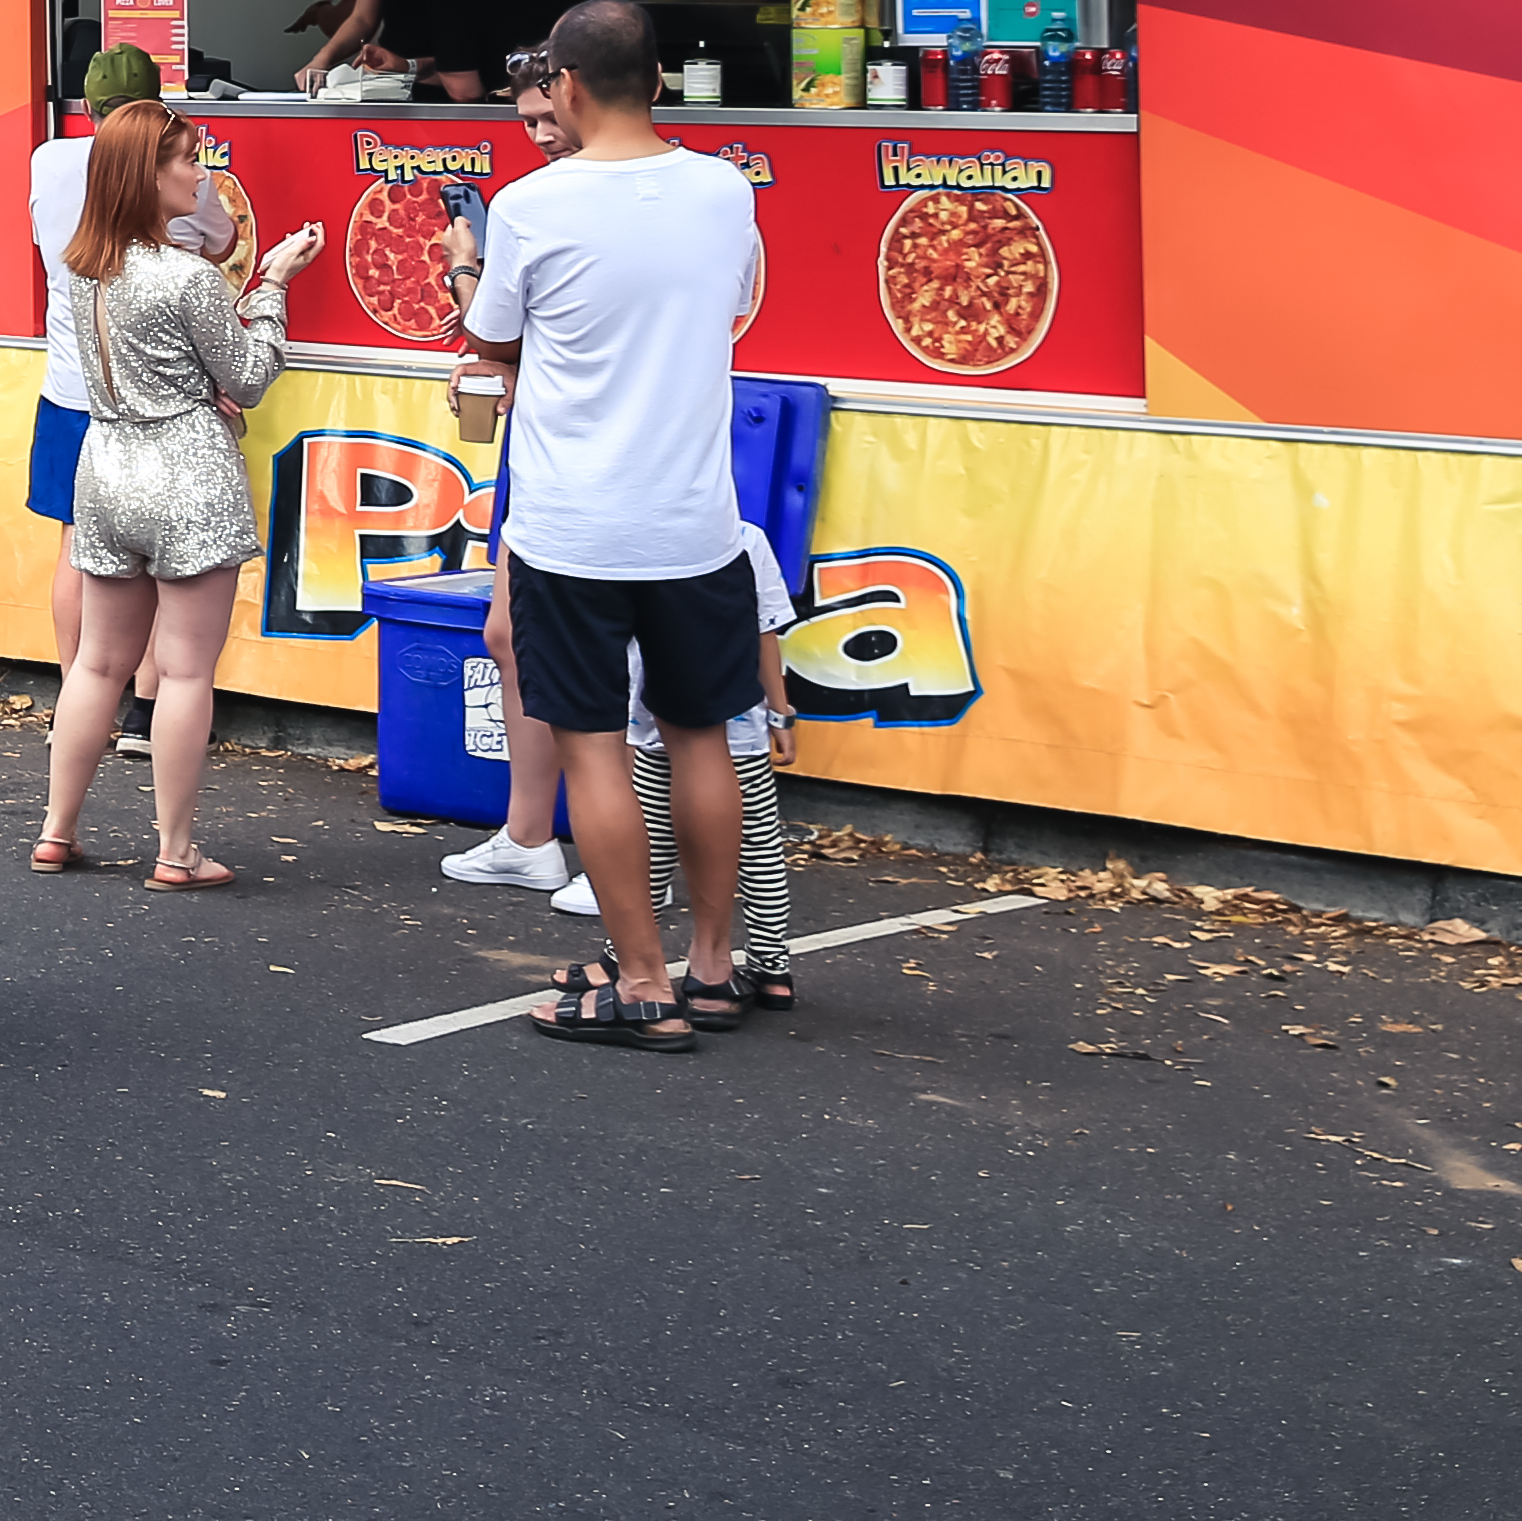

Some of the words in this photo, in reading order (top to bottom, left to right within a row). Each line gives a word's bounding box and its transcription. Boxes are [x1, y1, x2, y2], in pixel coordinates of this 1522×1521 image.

[978, 53, 1010, 75] Cola
[353, 130, 492, 183] Pepperoni
[878, 140, 1055, 193] Hawaiian
[466, 730, 506, 753] ICE
